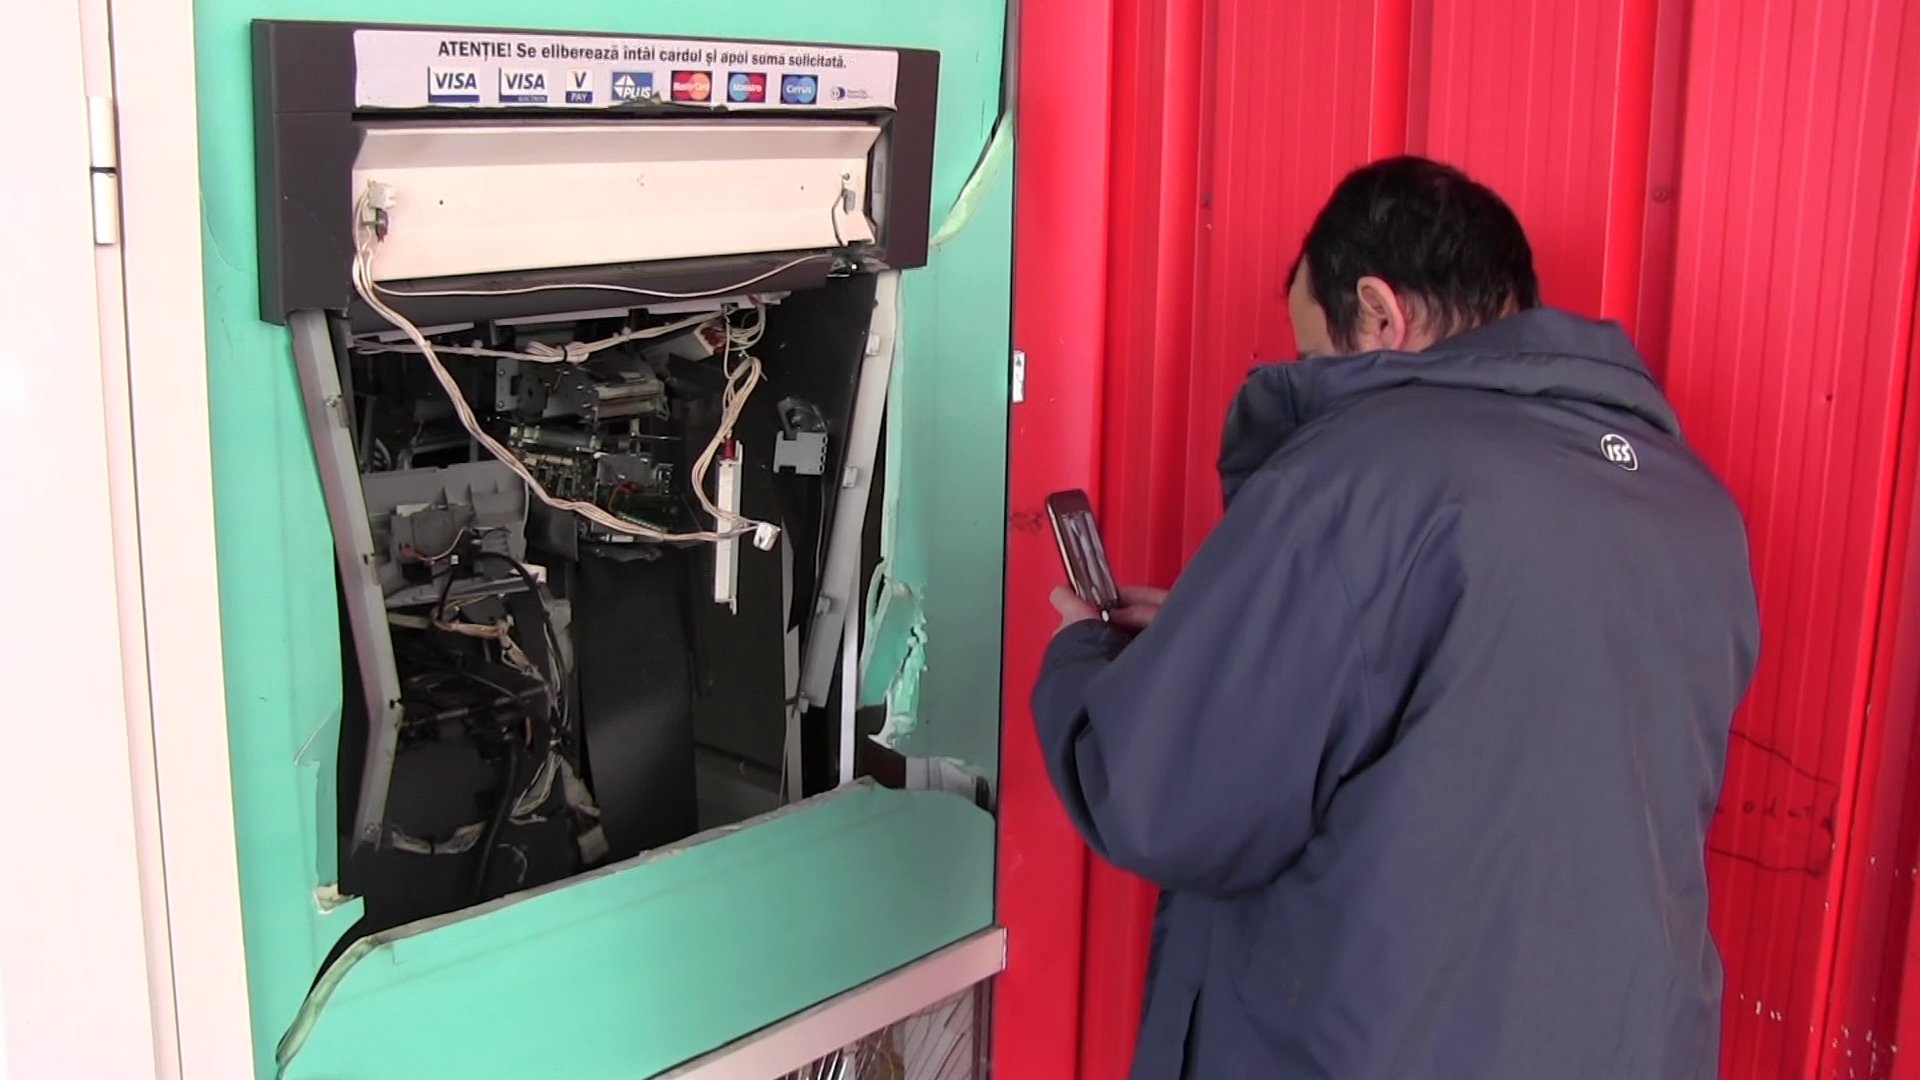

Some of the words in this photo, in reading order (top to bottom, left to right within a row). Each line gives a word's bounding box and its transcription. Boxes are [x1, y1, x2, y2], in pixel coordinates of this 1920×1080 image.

[516, 43, 537, 58] Se
[541, 43, 619, 60] eliberează
[659, 48, 702, 62] cardul
[720, 50, 748, 67] apoi
[434, 72, 477, 89] VISA
[504, 72, 545, 90] VISA
[572, 71, 587, 89] V
[571, 92, 589, 103] PAY
[623, 85, 652, 100] PLUS
